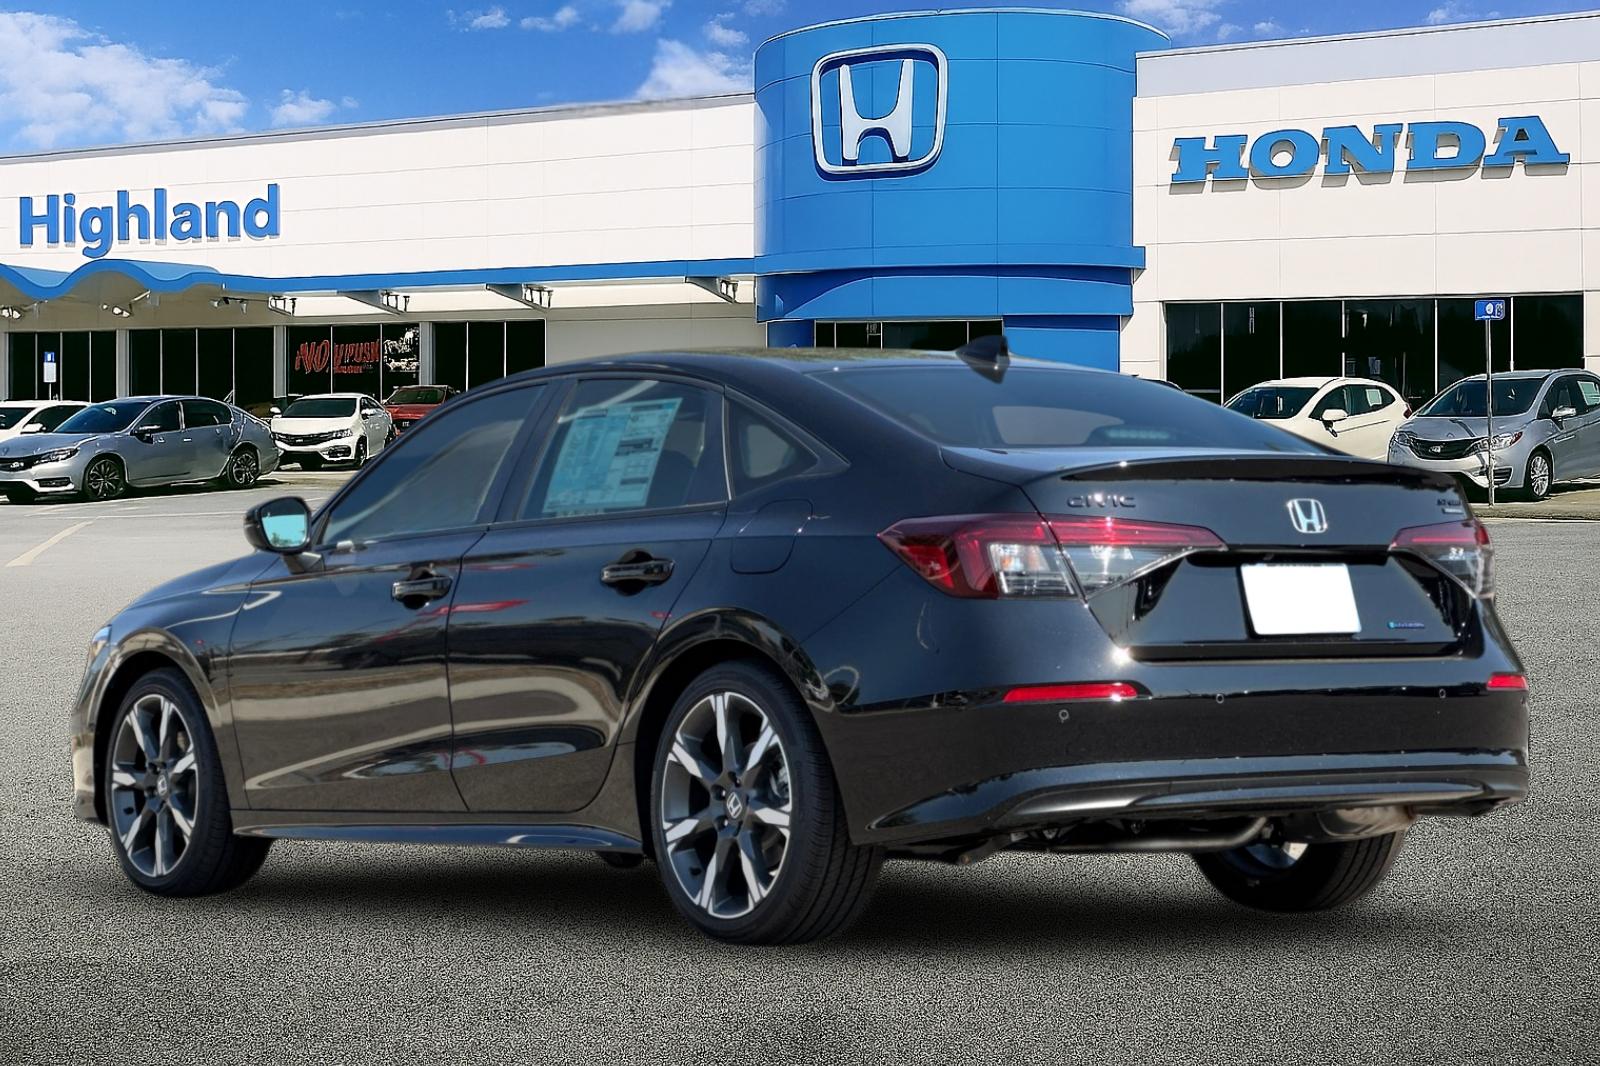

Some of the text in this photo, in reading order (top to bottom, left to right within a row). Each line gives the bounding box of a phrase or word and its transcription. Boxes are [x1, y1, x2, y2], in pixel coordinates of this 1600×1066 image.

[1170, 115, 1570, 183] HONDA
[19, 183, 281, 258] Highland
[1066, 494, 1136, 508] CIVIC
